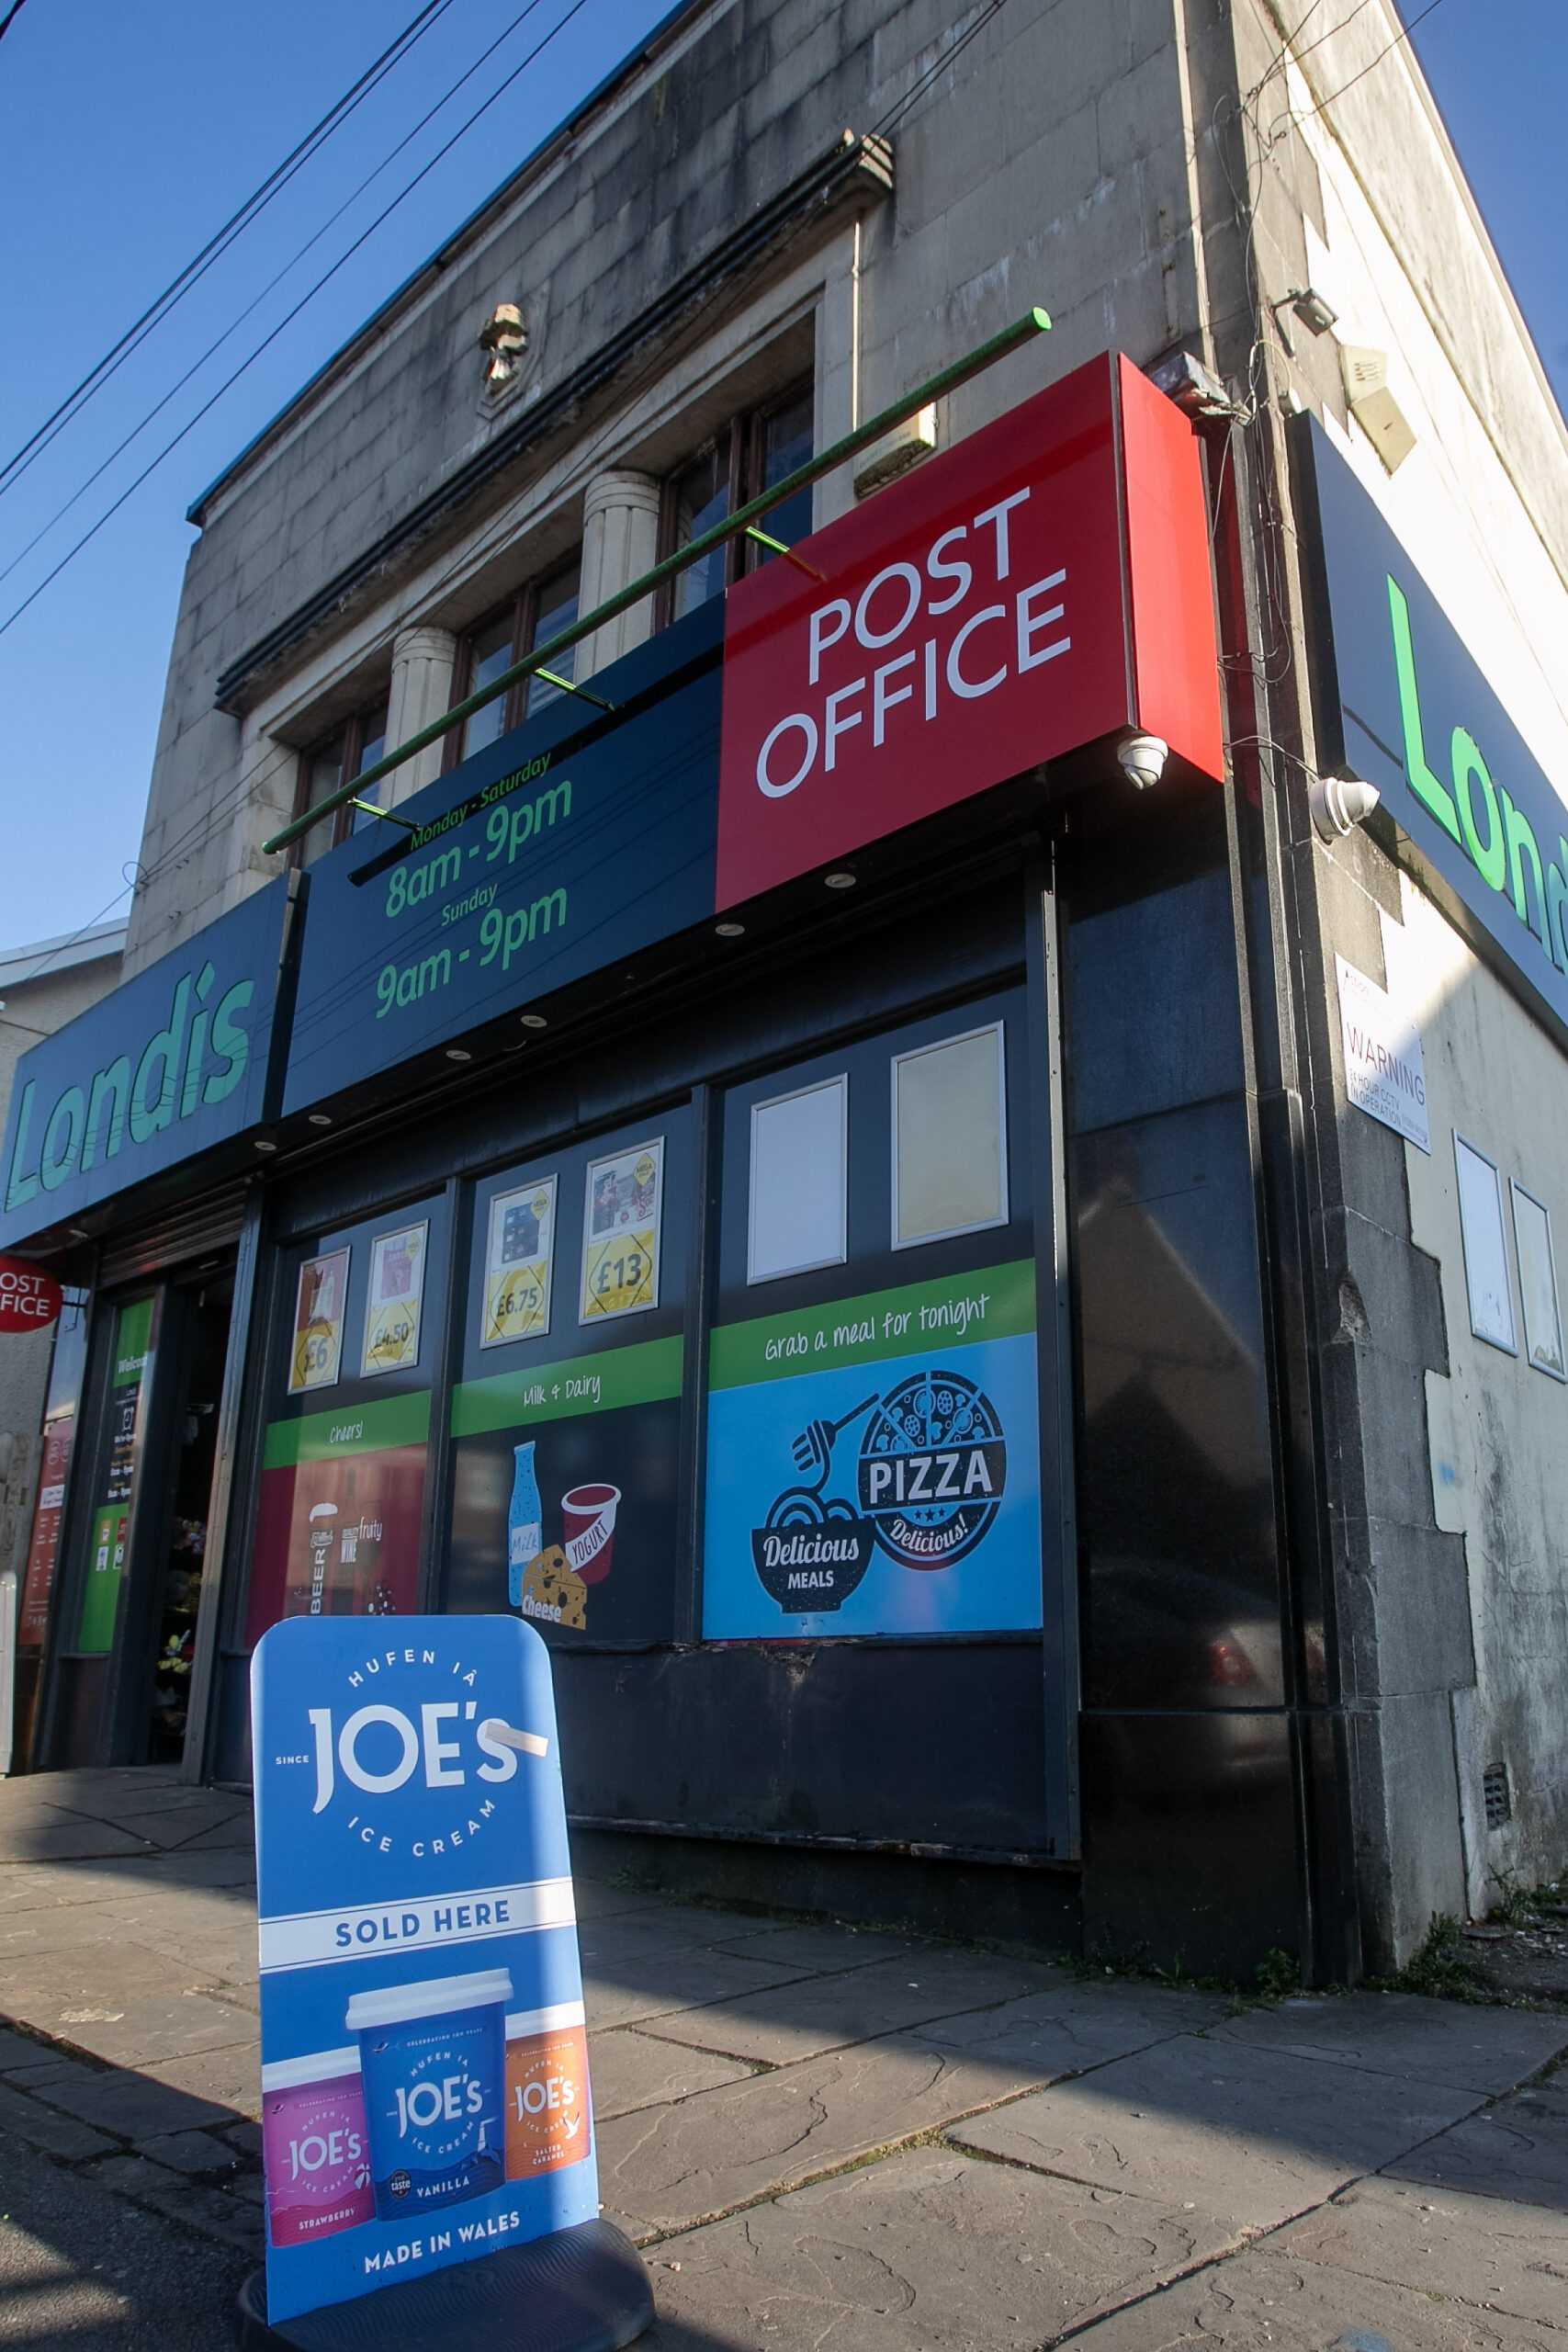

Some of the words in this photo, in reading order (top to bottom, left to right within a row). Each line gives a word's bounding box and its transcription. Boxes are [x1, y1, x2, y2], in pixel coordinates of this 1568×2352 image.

[808, 485, 1031, 686] POST
[756, 568, 1071, 798] OFFICE
[1386, 572, 1568, 984] Lon
[411, 805, 468, 851] Monday
[480, 752, 550, 808] Saturday
[386, 845, 461, 918] 8am
[486, 780, 572, 864] 9pm
[441, 883, 497, 927] Sunday
[376, 948, 451, 1019] 9am
[479, 888, 567, 970] 9pm
[1347, 1022, 1425, 1105] WARNING
[5, 959, 254, 1213] Londis
[1359, 1074, 1379, 1096] HOUR
[1381, 1089, 1399, 1111] CCTV
[1359, 1091, 1401, 1127] OPERATION
[0, 1272, 45, 1295] OST
[598, 1253, 641, 1295] £13
[0, 1293, 51, 1317] FICE
[496, 1287, 537, 1317] £6.75
[374, 1322, 409, 1348] £4.50
[765, 1331, 808, 1361] Grab
[814, 1329, 828, 1351] a
[832, 1316, 876, 1348] meal
[882, 1311, 912, 1339] for
[919, 1293, 991, 1336] tonight
[304, 1338, 328, 1373] £6
[524, 1385, 547, 1407] Milk
[565, 1374, 602, 1404] Dairy
[329, 1420, 363, 1443] Cheers!
[868, 1450, 993, 1504] PIZZA
[358, 1516, 382, 1542] fruity
[571, 1520, 608, 1565] YOGURT
[889, 1511, 969, 1553] Delicious!
[762, 1534, 860, 1567] Delicious
[310, 1548, 325, 1614] BEER
[787, 1570, 834, 1589] MEALS
[522, 1594, 562, 1623] Cheese
[348, 1649, 434, 1688] HUFEN
[276, 1755, 310, 1765] SINCE
[348, 1816, 392, 1853] ICE
[412, 1799, 495, 1858] CREAM
[335, 1914, 420, 1947] SOLD
[434, 1900, 510, 1932] HERE
[406, 2034, 450, 2047] CELEBRATING
[410, 2052, 451, 2076] HUFEN
[525, 2060, 552, 2078] HUFEN
[301, 2111, 335, 2132] HUFEN
[412, 2137, 430, 2154] ICE
[438, 2121, 474, 2154] CREAM
[526, 2120, 539, 2133] ICE
[533, 2150, 565, 2165] CARAMEL
[535, 2143, 561, 2156] SALTED
[301, 2179, 318, 2193] ICE
[323, 2166, 353, 2193] CREAM
[390, 2179, 411, 2190] taste
[417, 2176, 470, 2198] VANILLA
[299, 2207, 355, 2231] STRAWBERRY
[365, 2240, 423, 2274] MADE
[430, 2231, 452, 2253] IN
[457, 2211, 521, 2244] WALES
